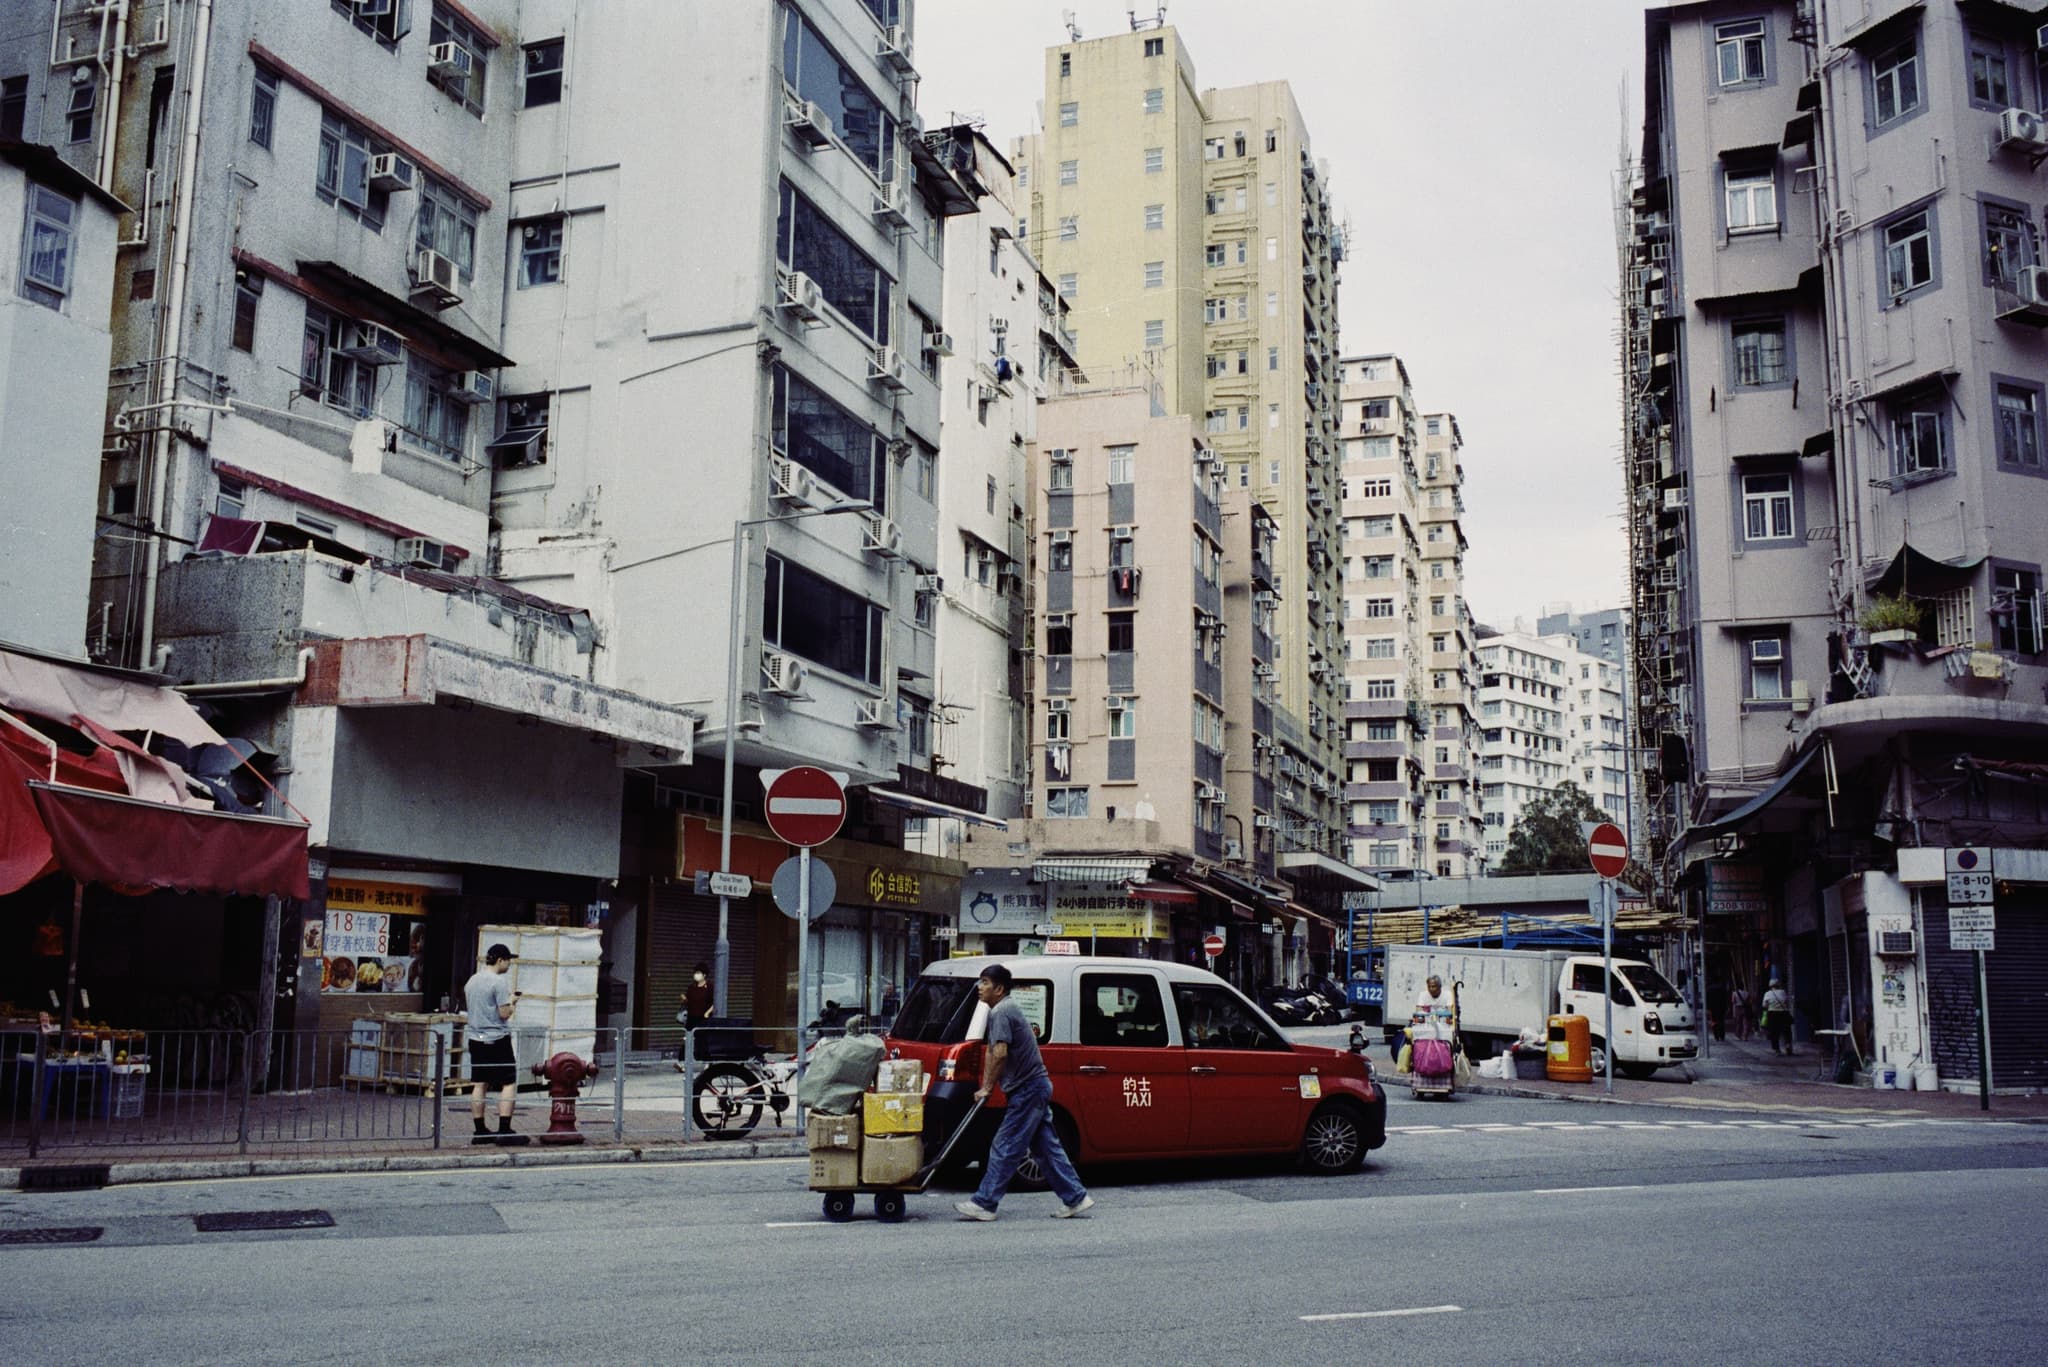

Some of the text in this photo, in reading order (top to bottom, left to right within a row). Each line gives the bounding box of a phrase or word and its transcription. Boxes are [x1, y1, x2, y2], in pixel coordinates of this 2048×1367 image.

[888, 873, 920, 895] 合信的士
[1963, 876, 1990, 885] 8-10
[1356, 986, 1383, 1000] 5122
[1123, 1076, 1151, 1091] 的士
[1123, 1091, 1152, 1107] TAXI
